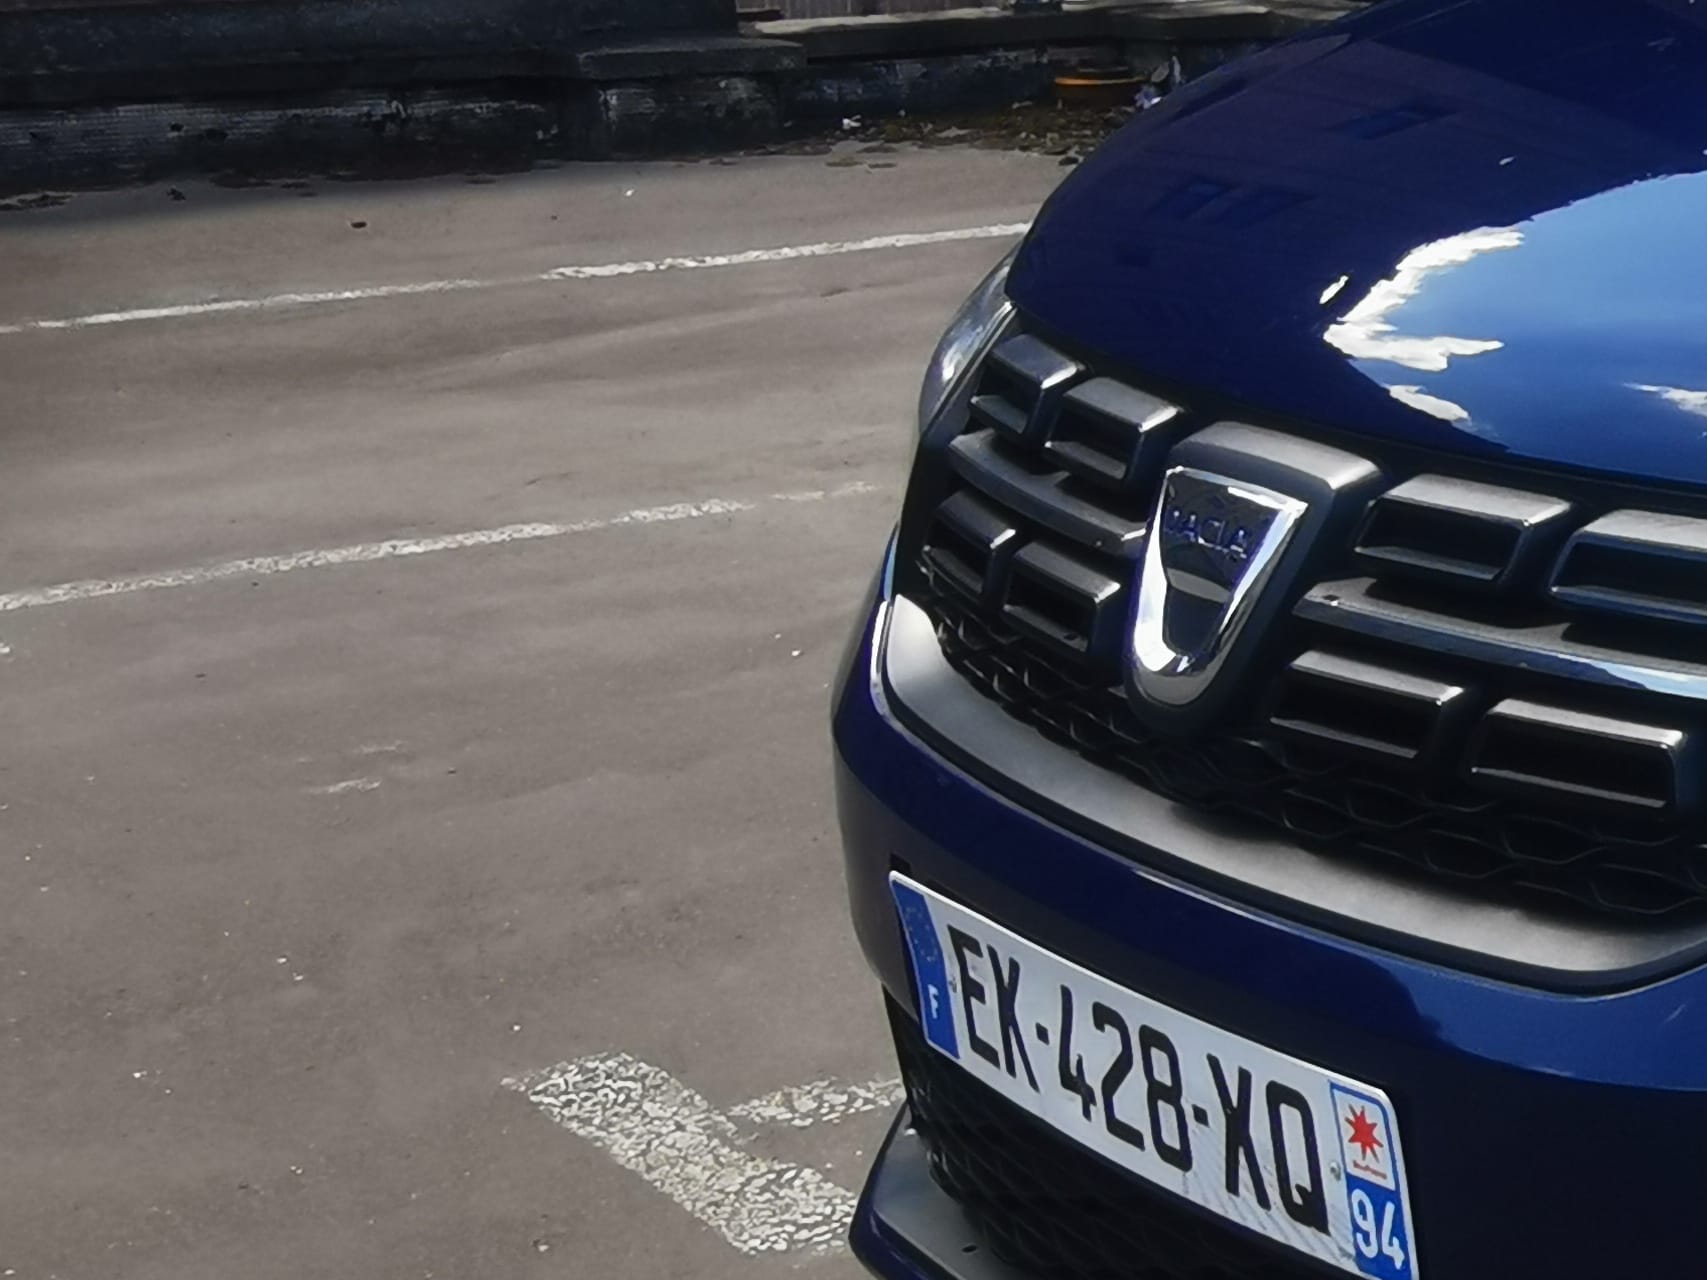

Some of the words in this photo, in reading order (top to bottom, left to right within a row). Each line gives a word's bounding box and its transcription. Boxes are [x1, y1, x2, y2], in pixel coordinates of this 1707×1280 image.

[927, 983, 940, 1019] F
[947, 924, 1331, 1236] EK-428-XQ
[1351, 1188, 1405, 1270] 94
